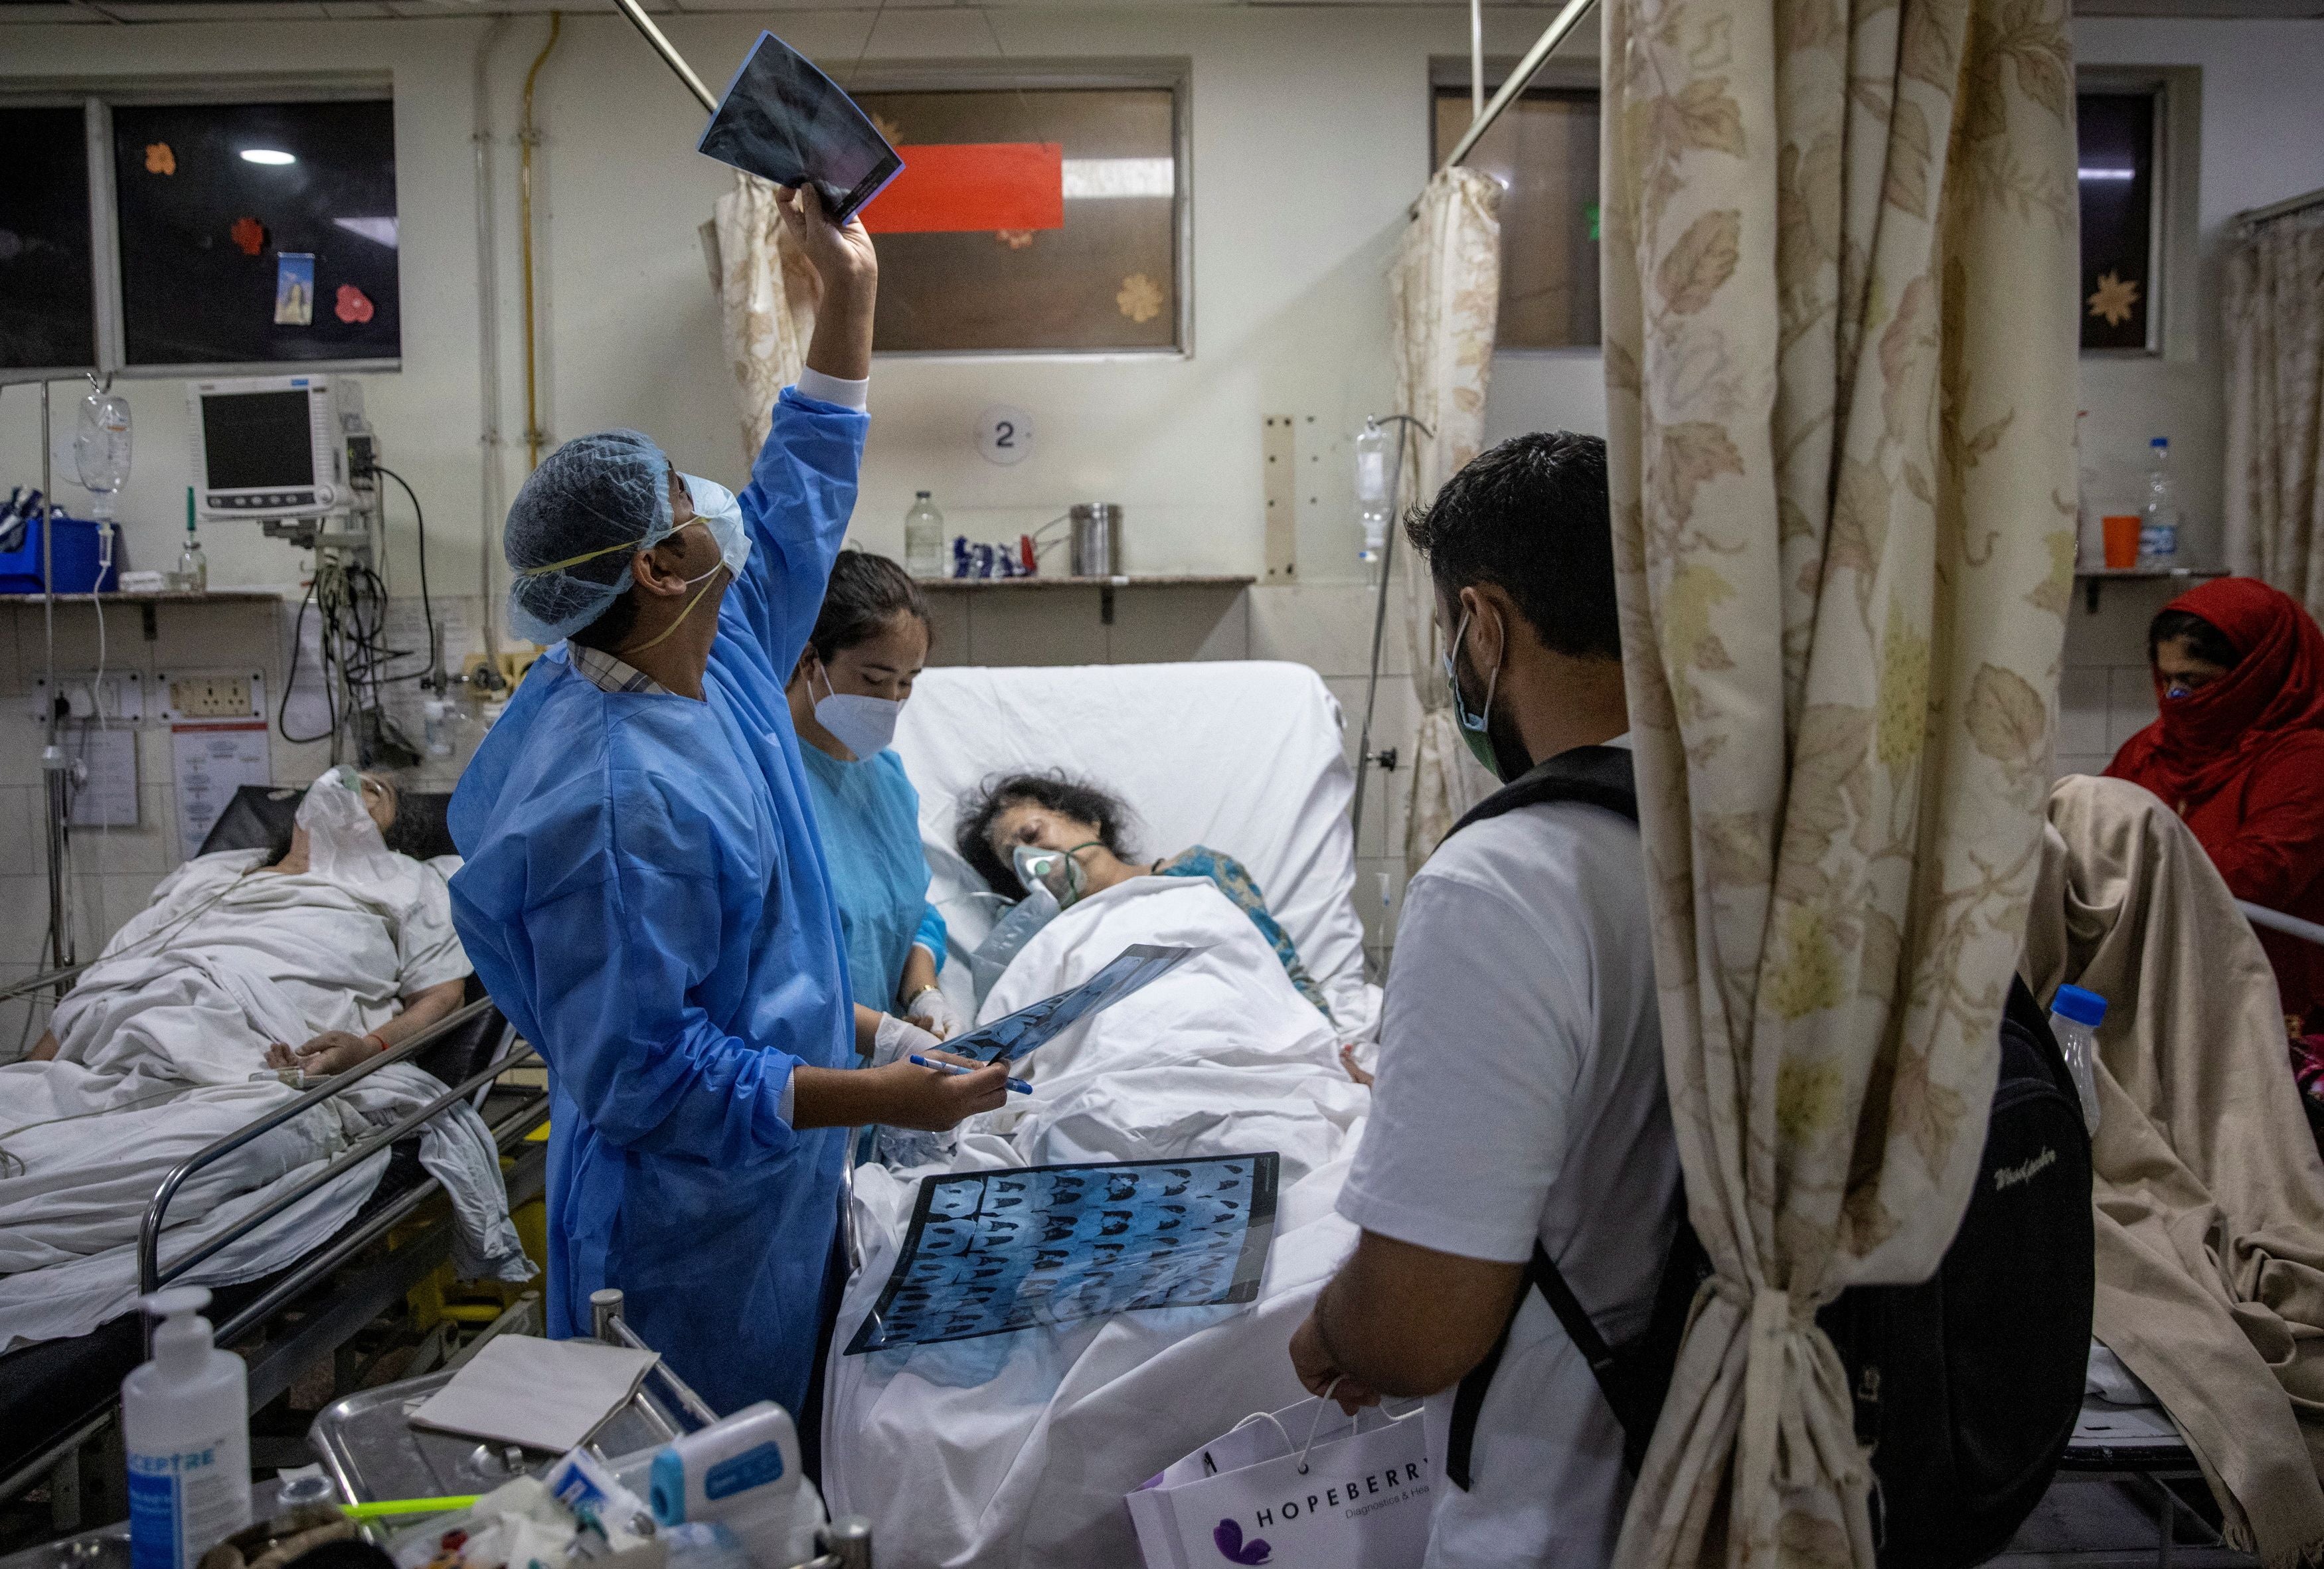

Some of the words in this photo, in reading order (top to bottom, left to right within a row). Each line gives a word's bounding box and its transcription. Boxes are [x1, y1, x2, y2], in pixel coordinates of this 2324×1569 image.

[997, 421, 1014, 447] 2
[1256, 1457, 1428, 1527] HOPEBERR
[1345, 1496, 1400, 1519] Diagnostics
[1402, 1491, 1409, 1501] &
